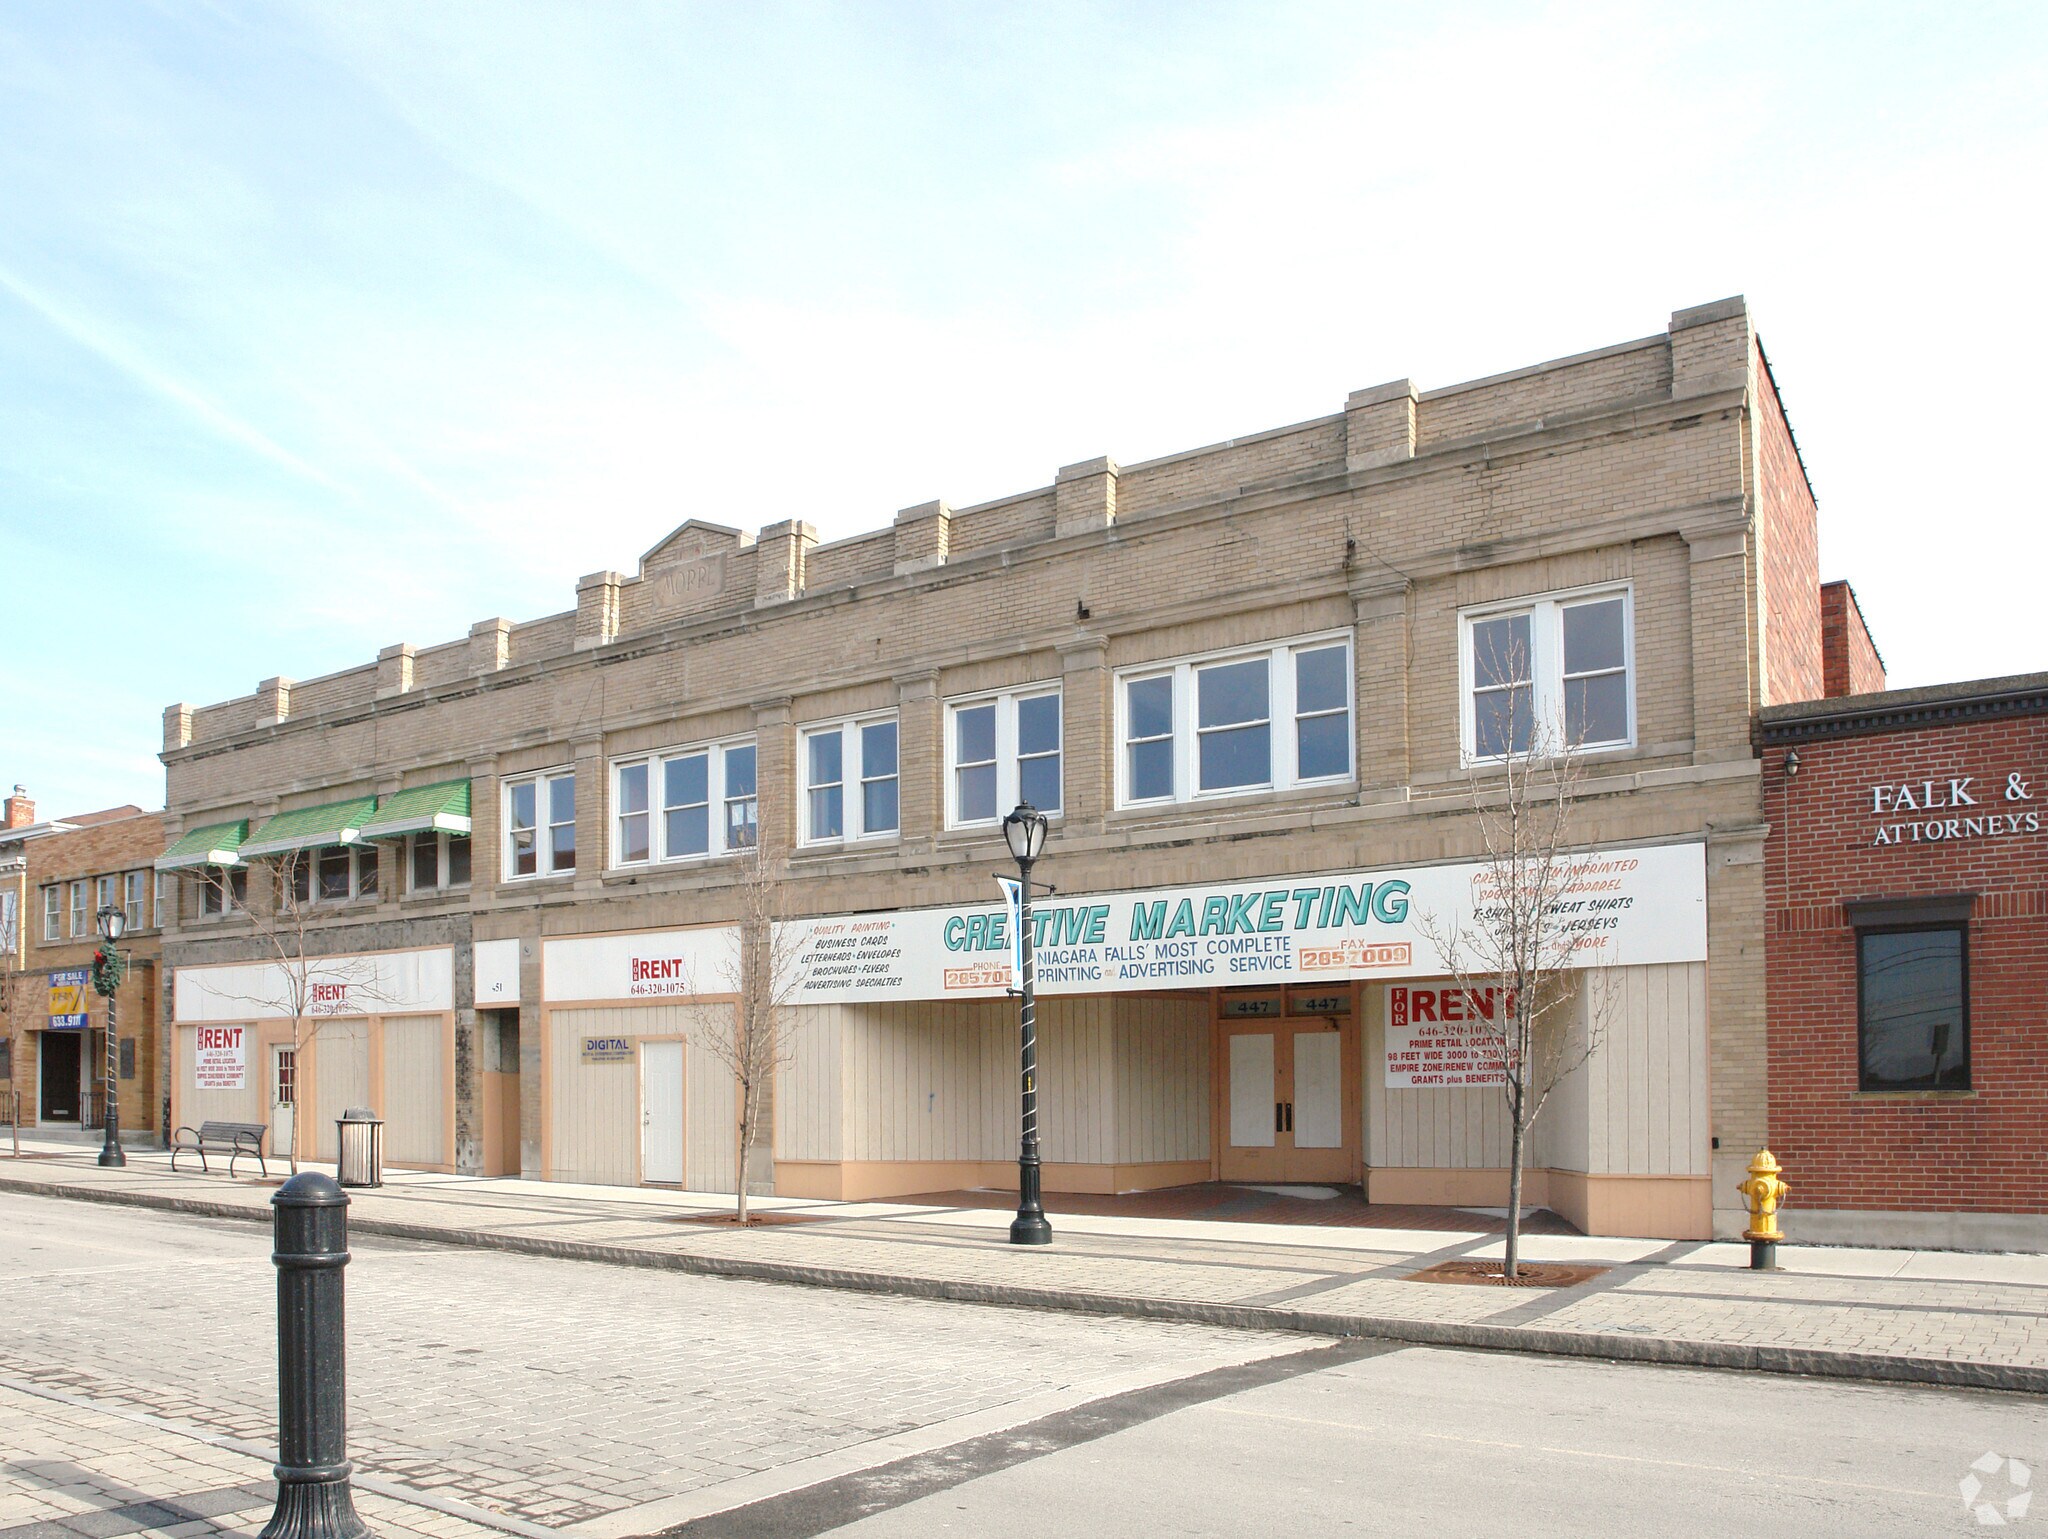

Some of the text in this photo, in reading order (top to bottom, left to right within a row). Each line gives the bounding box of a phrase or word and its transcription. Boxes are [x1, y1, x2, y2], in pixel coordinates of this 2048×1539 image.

[1871, 773, 2032, 813] FALK &
[1874, 813, 2039, 846] ATTORNEYS
[1567, 879, 1622, 894] APPAREL
[1587, 897, 1633, 911] SHIRTS
[944, 880, 1411, 951] CRETIVE MARKETING
[814, 921, 890, 935] QUALITY PRINTING
[1561, 917, 1618, 932] JERSEYS
[815, 936, 888, 949] BUSINESS CARDS
[1341, 938, 1365, 948] FAX
[1573, 936, 1609, 949] MORE
[801, 949, 901, 963] LETTERHEADS ENVELOPES
[1038, 949, 1097, 966] NIAGARA
[1156, 941, 1198, 959] MOST
[1207, 936, 1290, 955] COMPLETE
[640, 959, 682, 979] RENT
[812, 964, 889, 976] BROCHURES FLYERS
[973, 961, 1001, 971] PHONE
[1038, 966, 1102, 982] PRINTING
[1119, 959, 1214, 979] ADVERTISING
[1230, 955, 1292, 972] SERVICE
[68, 972, 82, 980] SALE
[631, 983, 684, 994] 646-320-1075
[804, 977, 902, 990] ADVERTISING SPECIALTIES
[319, 985, 347, 1000] RENT
[1238, 1002, 1268, 1013] 447
[1306, 998, 1338, 1010] 447
[1394, 990, 1406, 1024] FOR
[1412, 988, 1516, 1022] RENT
[205, 1029, 242, 1048] RENT
[587, 1040, 628, 1050] DIGITAL
[1410, 1040, 1432, 1048] PRIME
[1436, 1038, 1462, 1047] RETAIL
[1401, 1052, 1420, 1060] FEET
[1424, 1052, 1442, 1060] WIDE
[1447, 1051, 1467, 1059] 3000
[1390, 1064, 1419, 1072] EMPIRE
[1423, 1062, 1473, 1071] ZONE/RENEW
[1412, 1074, 1505, 1085] GRANTS plus BENEFITS
